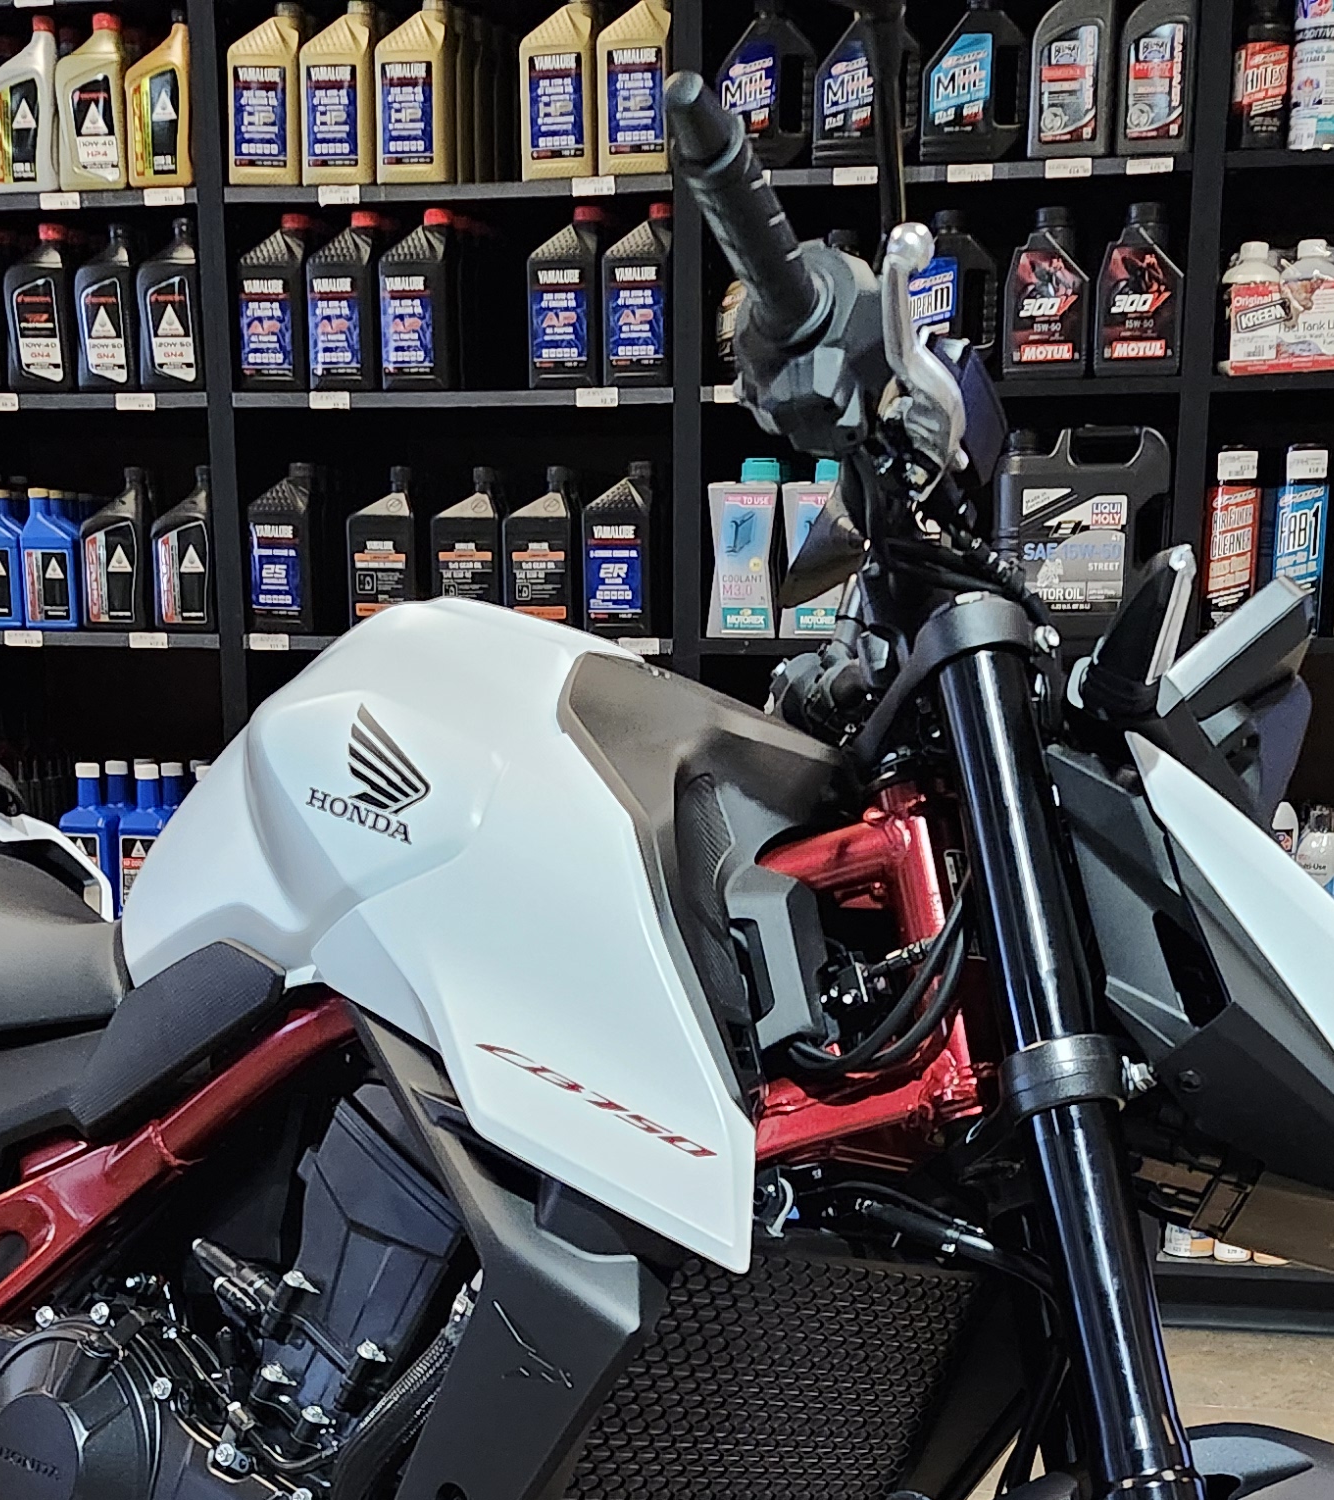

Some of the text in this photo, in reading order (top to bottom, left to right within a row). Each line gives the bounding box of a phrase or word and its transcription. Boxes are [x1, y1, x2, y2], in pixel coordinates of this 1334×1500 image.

[534, 53, 578, 71] YAMALUBE
[612, 48, 657, 65] YAMALUBE
[238, 67, 280, 81] YAMALUBE
[310, 66, 352, 81] YAMALUBE
[385, 63, 426, 78] YAMALUBE
[243, 280, 284, 294] YAMALUBE
[312, 277, 352, 292] YAMALUBE
[385, 276, 425, 291] YAMALUBE
[1020, 295, 1079, 317] 300V
[1111, 292, 1171, 313] 300V
[1234, 296, 1272, 308] Original
[542, 311, 577, 327] AP
[619, 308, 654, 325] AP
[1240, 305, 1286, 328] KREEM
[1301, 320, 1326, 332] Tank
[1023, 344, 1071, 360] MOTUL
[1114, 341, 1163, 357] MOTUL
[743, 496, 769, 505] TO USE
[1093, 503, 1122, 513] LIQUI
[1092, 513, 1122, 525] MOLY
[1024, 543, 1057, 560] SAE
[1088, 562, 1119, 571] STREET
[722, 574, 763, 583] COOLANT
[722, 585, 752, 596] M3.0
[1064, 588, 1084, 600] OIL
[727, 615, 765, 625] MOTOREX
[306, 786, 412, 845] HONDA
[474, 1042, 718, 1158] CB750
